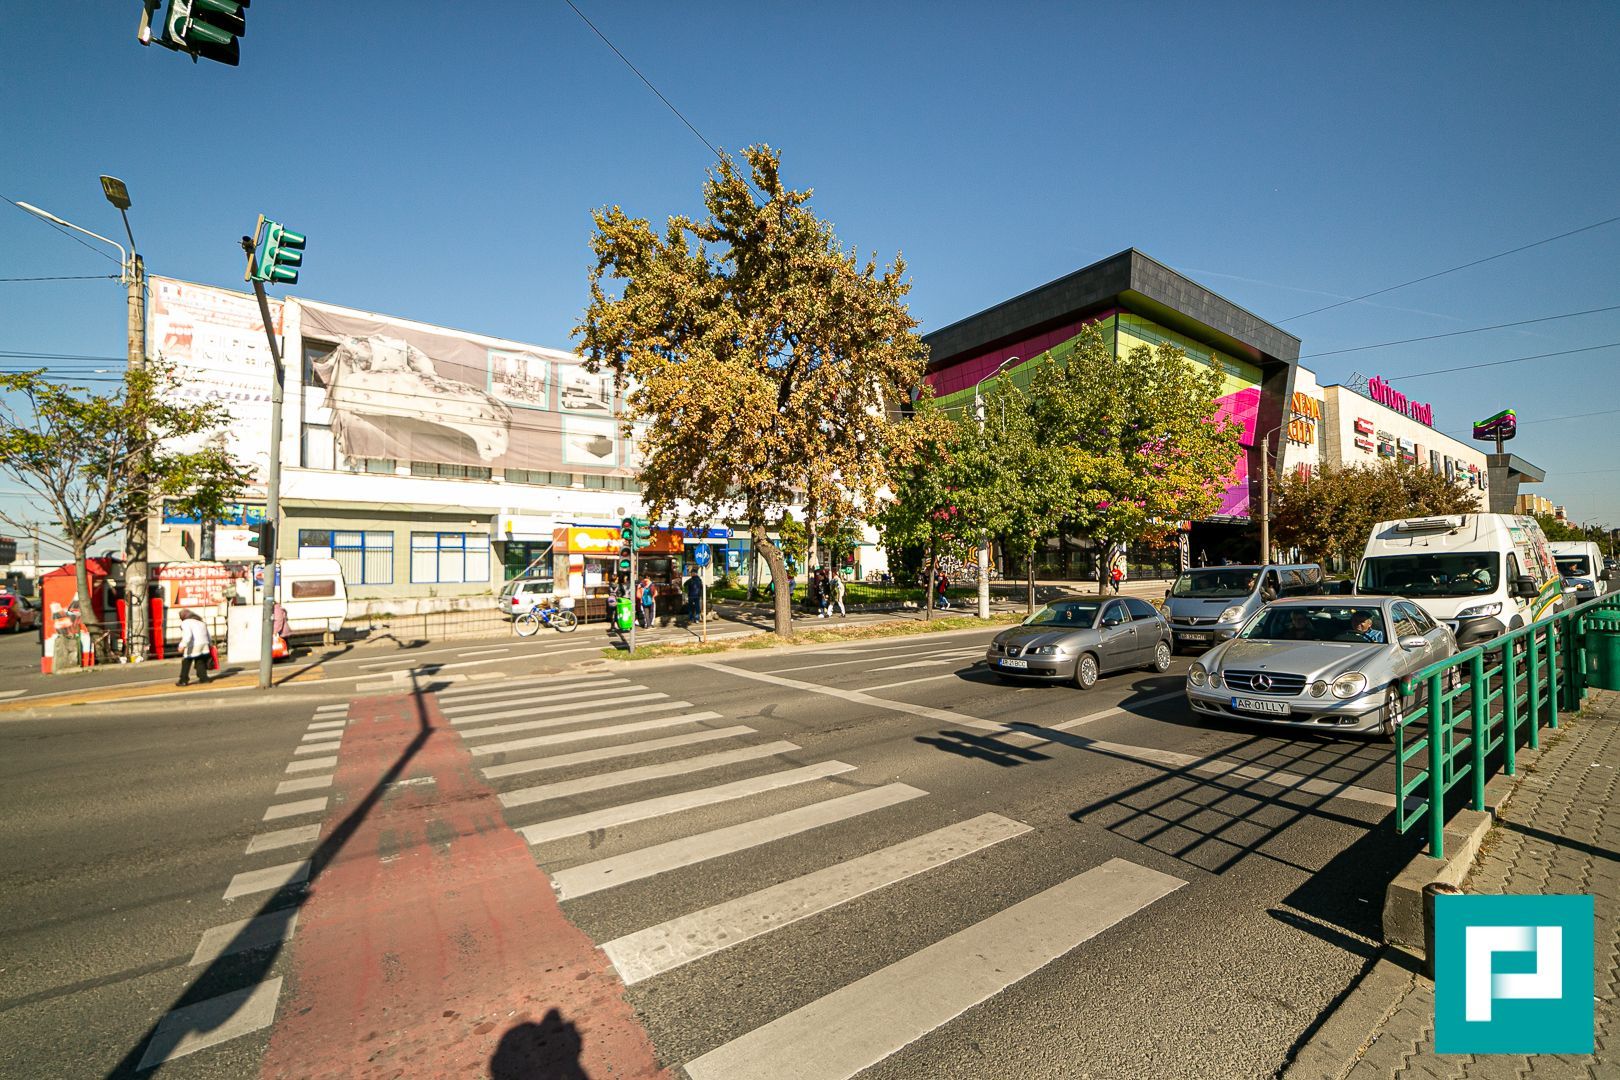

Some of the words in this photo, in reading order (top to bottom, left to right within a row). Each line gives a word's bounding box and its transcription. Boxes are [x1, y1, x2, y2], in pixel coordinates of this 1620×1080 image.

[1291, 391, 1322, 420] NEMA
[1368, 375, 1408, 416] atrium
[1410, 400, 1433, 427] mall
[1287, 420, 1315, 444] CITY
[1238, 699, 1252, 708] AR
